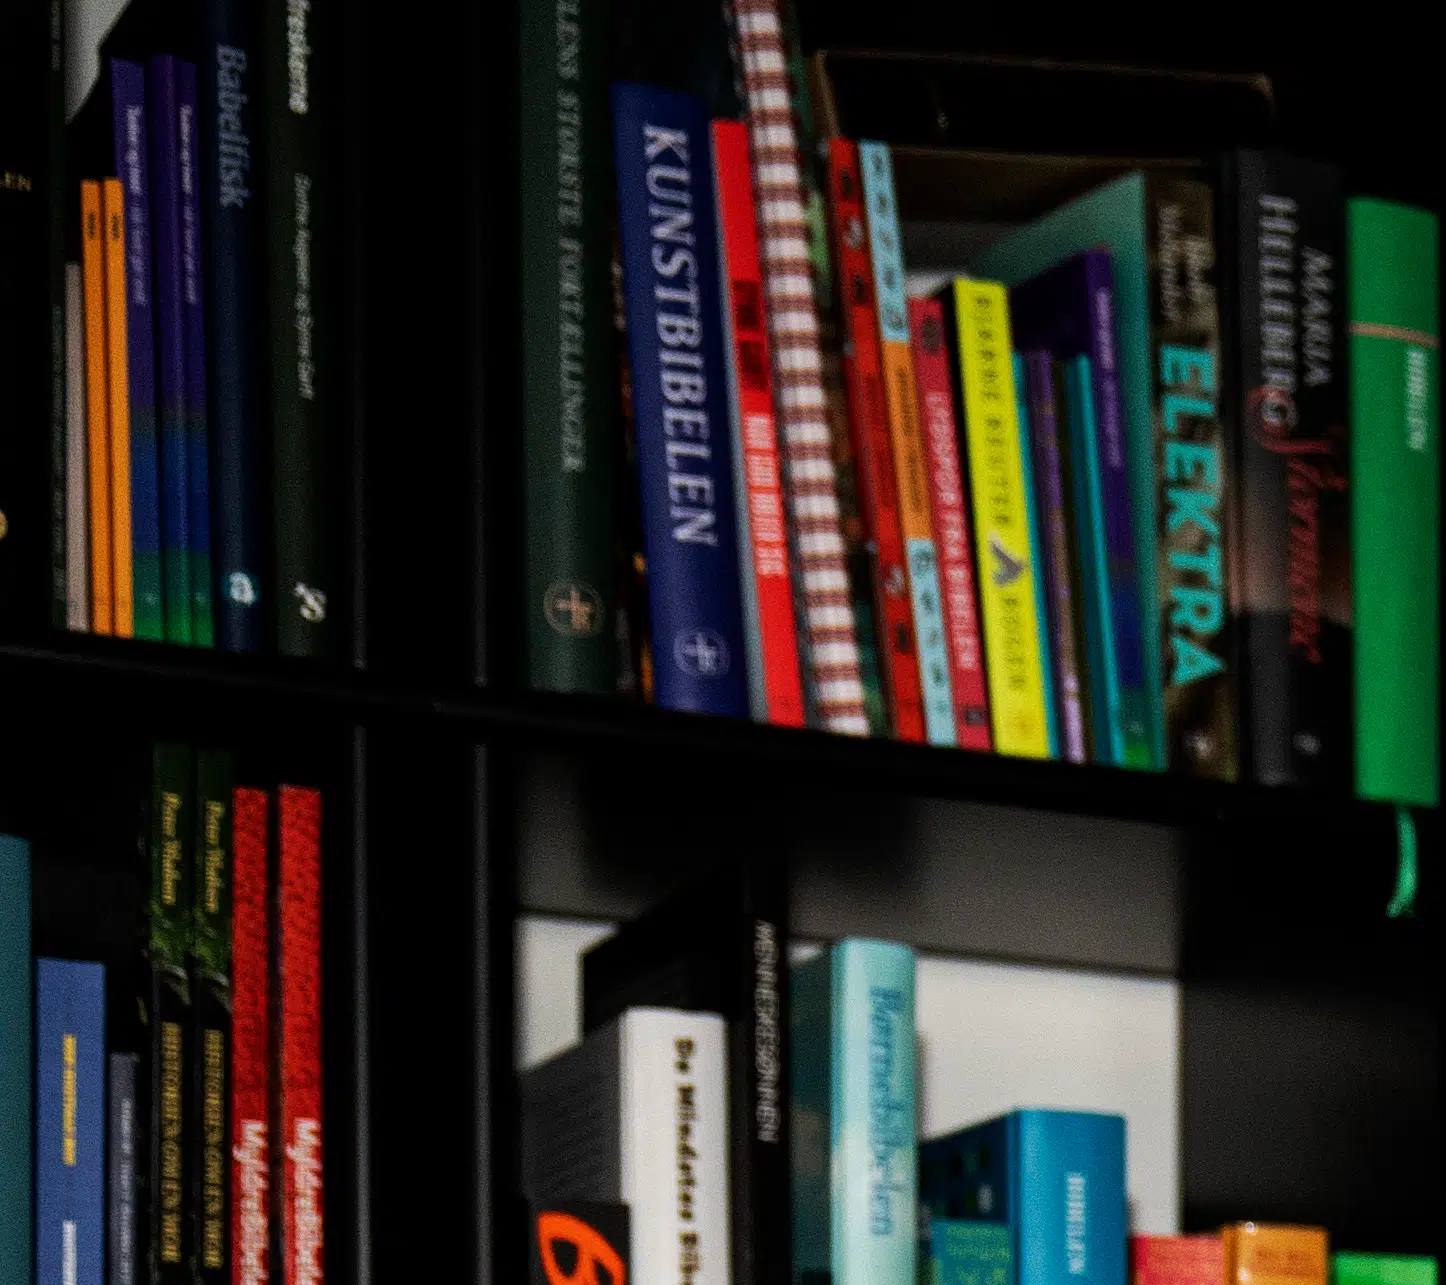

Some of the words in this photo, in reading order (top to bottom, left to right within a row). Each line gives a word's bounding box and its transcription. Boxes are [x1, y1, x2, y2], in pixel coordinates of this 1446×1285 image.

[642, 123, 718, 547] KUNSTBIBELEN
[1299, 247, 1334, 387] MARIA
[1158, 343, 1226, 686] ELEKTRA
